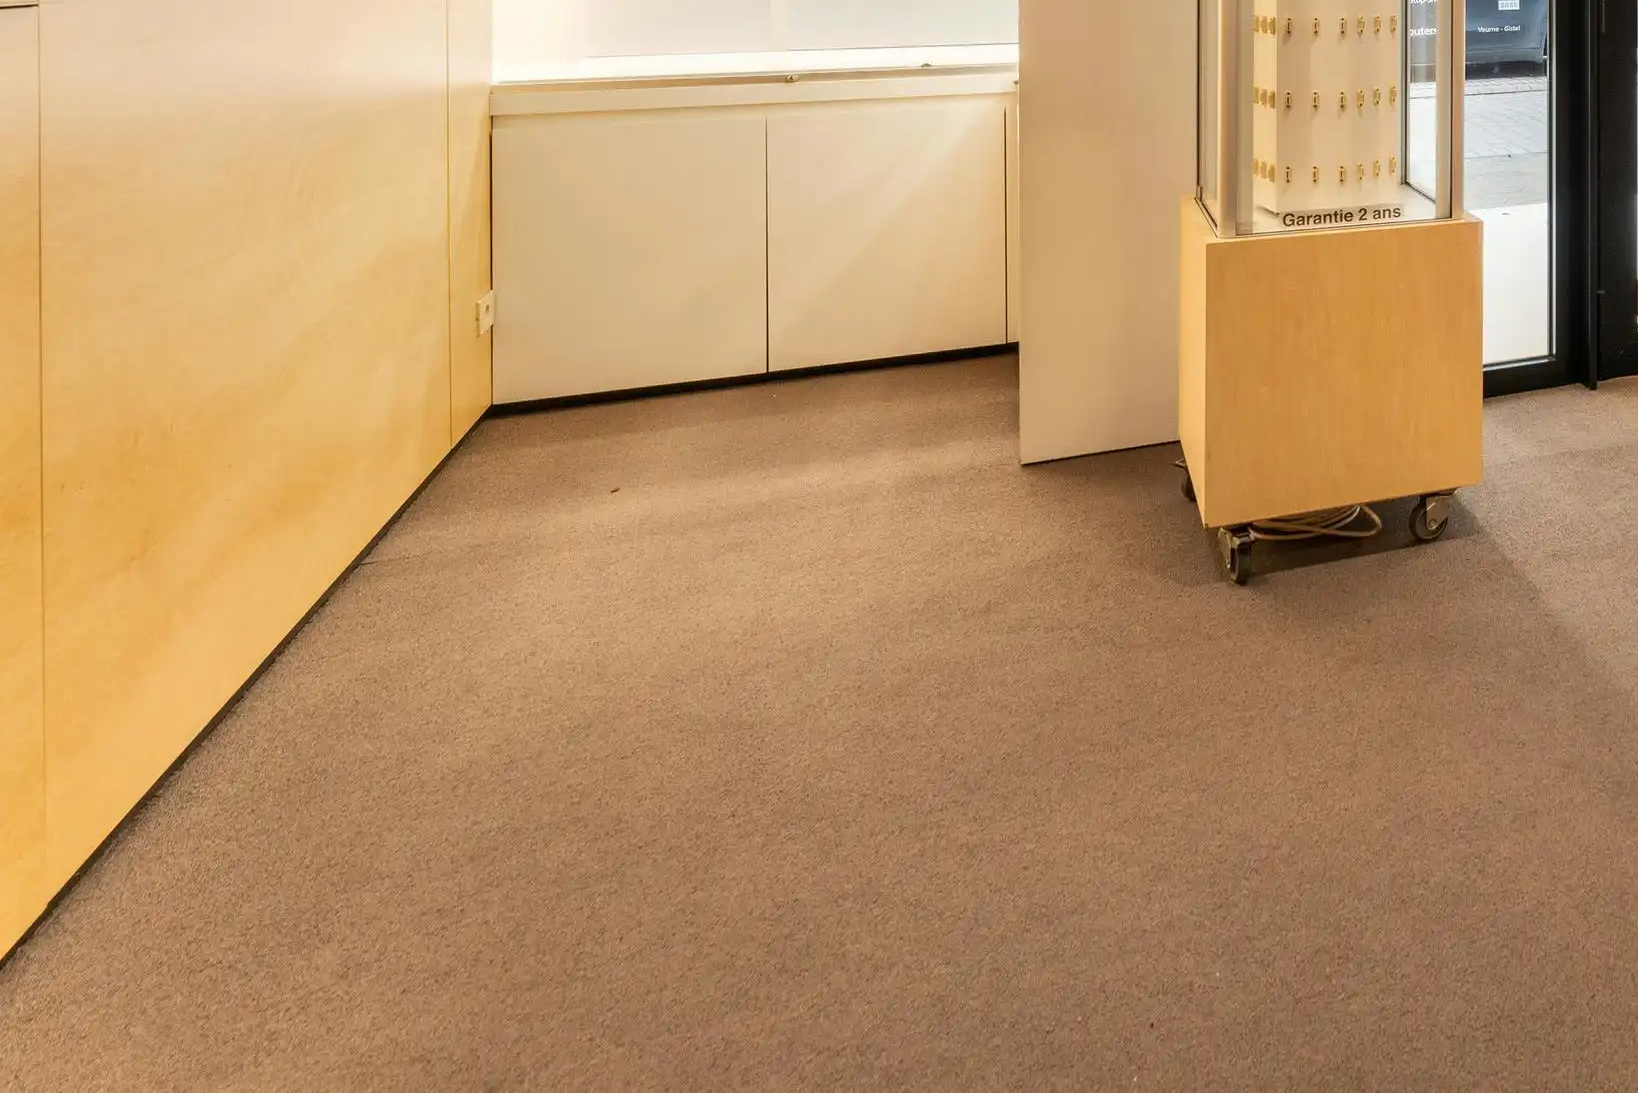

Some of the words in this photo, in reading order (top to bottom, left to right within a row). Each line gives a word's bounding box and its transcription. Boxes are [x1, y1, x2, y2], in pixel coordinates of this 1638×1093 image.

[1282, 209, 1354, 228] Garantie
[1358, 207, 1368, 221] 2
[1372, 206, 1402, 220] ans
